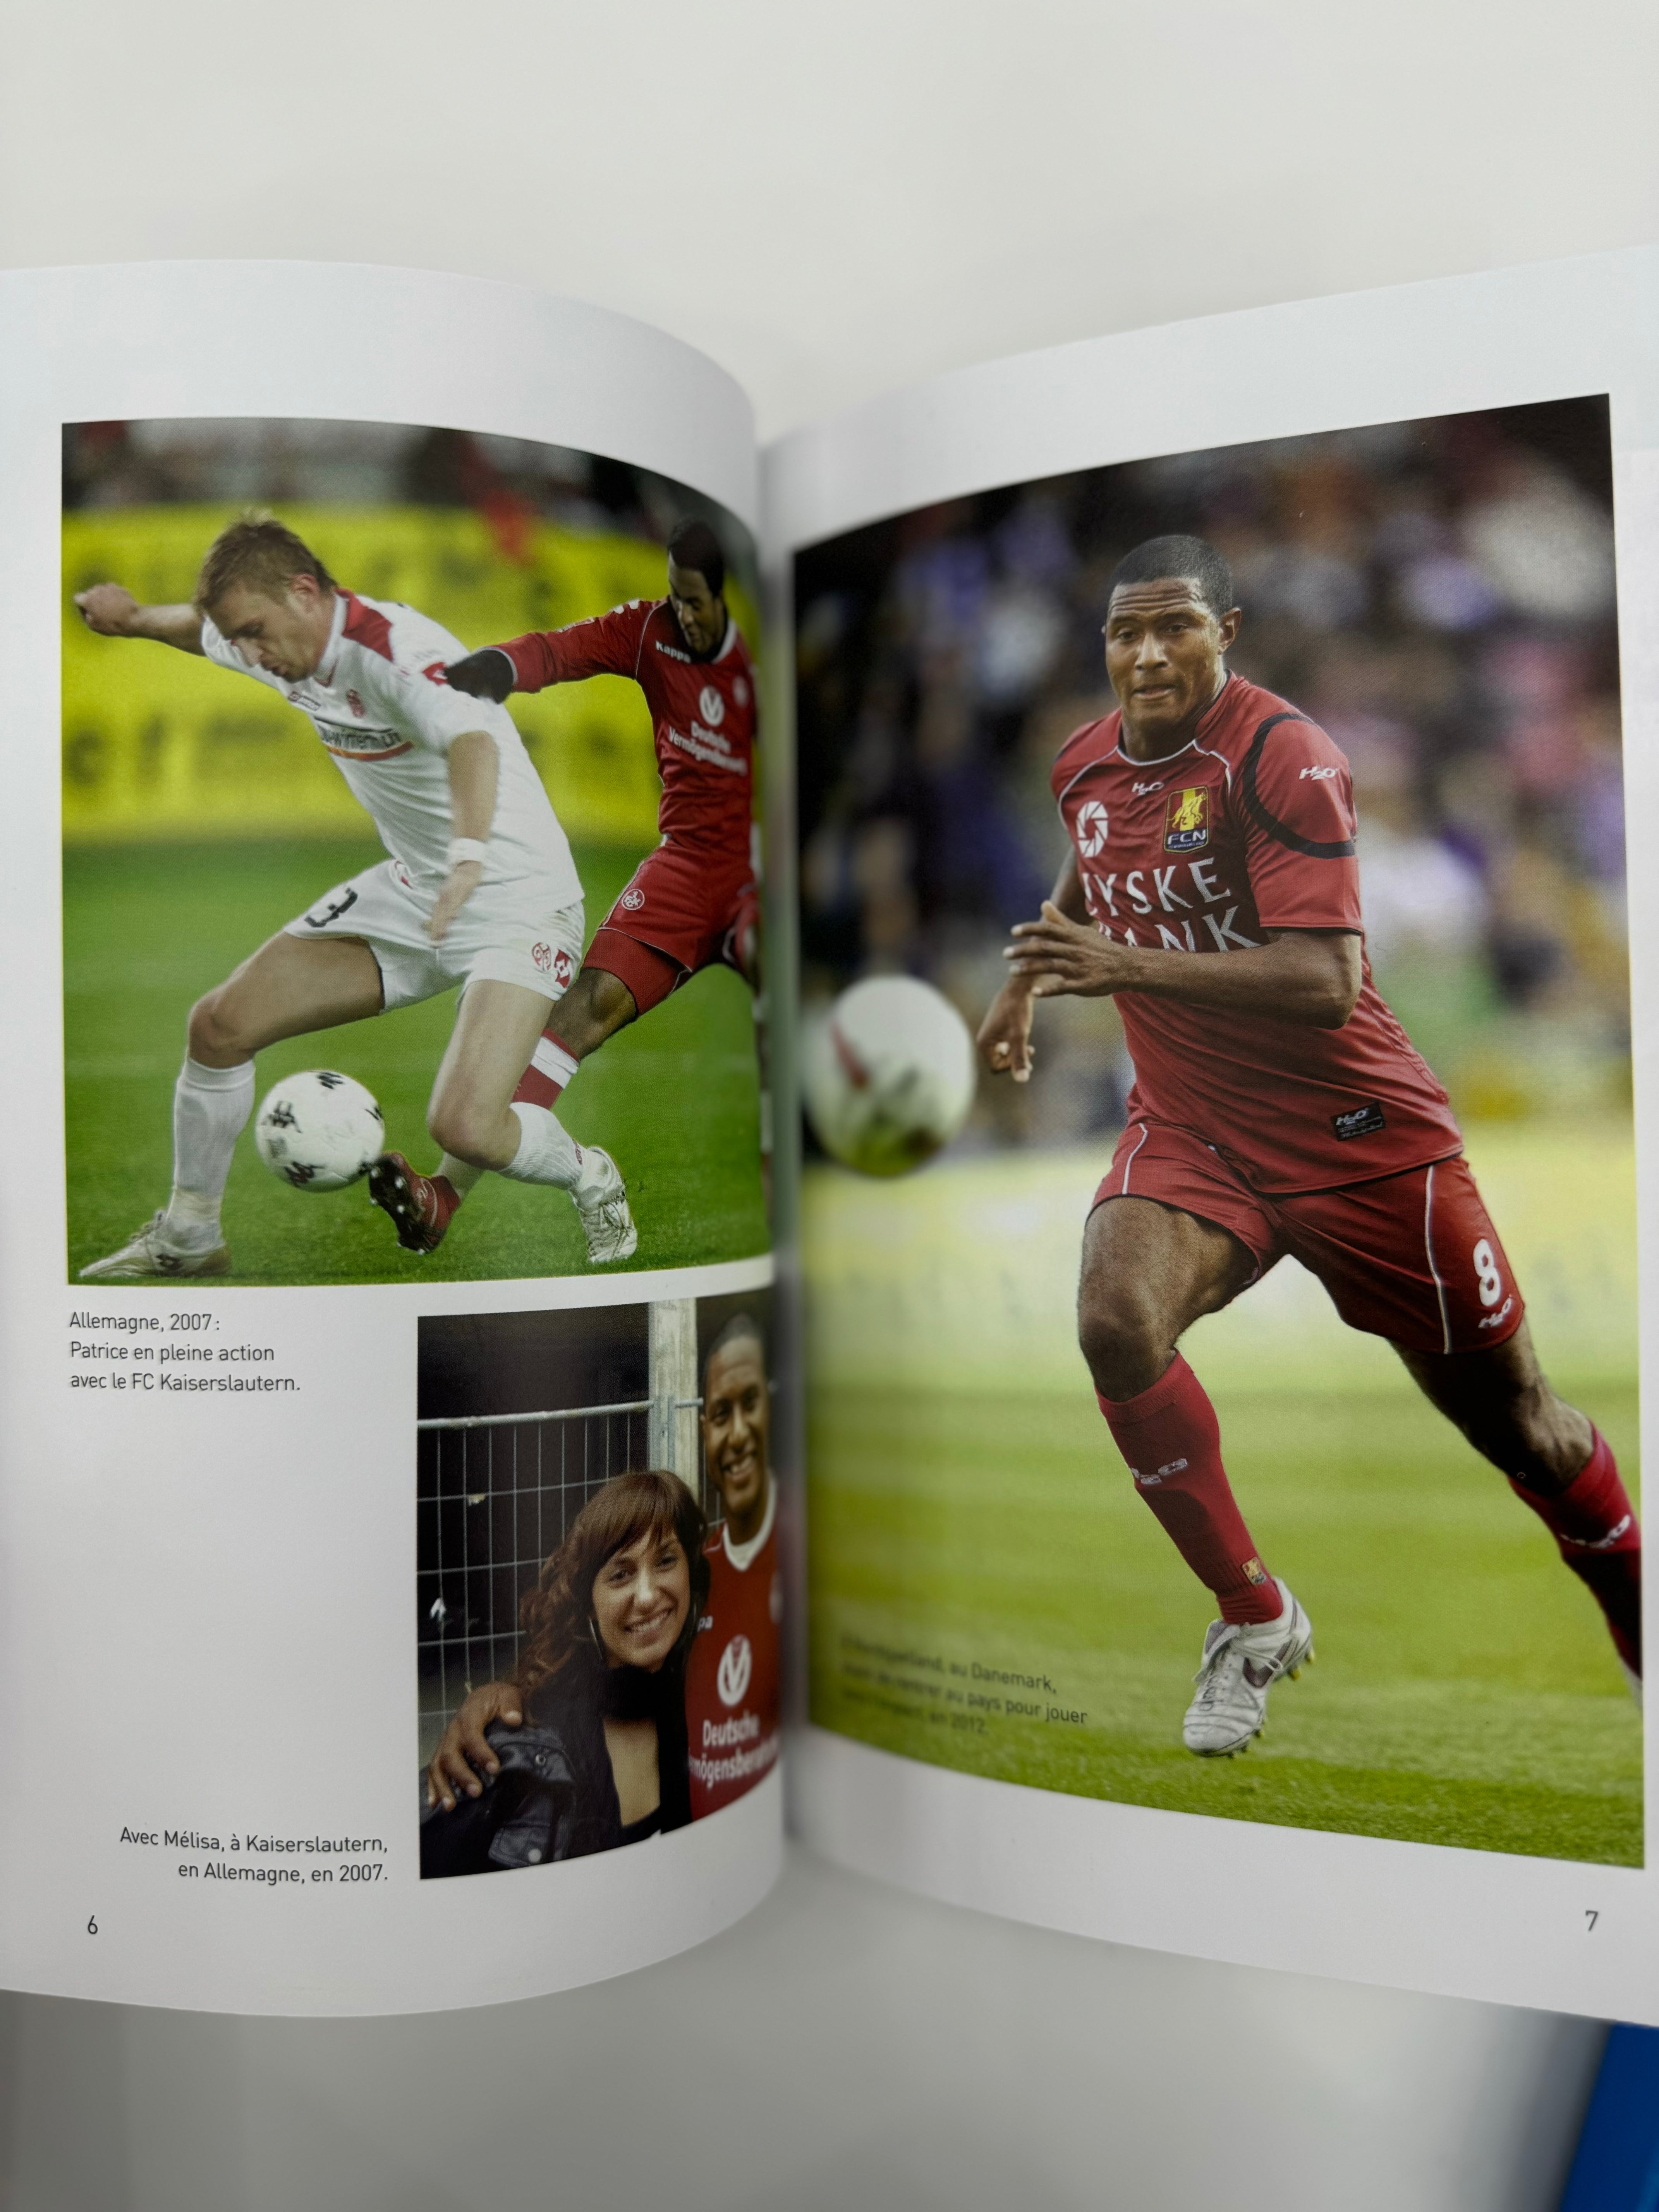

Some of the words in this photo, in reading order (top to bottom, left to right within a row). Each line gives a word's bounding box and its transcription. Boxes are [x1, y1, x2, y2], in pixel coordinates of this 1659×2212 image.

[1167, 830, 1206, 845] FCN
[1473, 1239, 1501, 1307] 8
[69, 1311, 164, 1334] Allemagne,
[70, 1341, 129, 1360] Patrice
[132, 1347, 154, 1360] en
[159, 1343, 213, 1365] pleine
[218, 1344, 274, 1361] action
[70, 1375, 107, 1389] avec
[112, 1372, 127, 1390] le
[131, 1372, 154, 1391] FC
[160, 1373, 301, 1392] Kaiserslautern.
[971, 1662, 1058, 1695] Danemark,
[967, 1692, 1001, 1712] pays
[1006, 1700, 1041, 1717] pour
[1045, 1702, 1088, 1725] jouer
[120, 1826, 159, 1846] Avec
[164, 1830, 225, 1853] Mélisa,
[230, 1833, 240, 1851] à
[246, 1834, 388, 1854] Kaiserslautern,
[178, 1865, 199, 1877] en
[203, 1862, 305, 1886] Allemagne,
[311, 1870, 333, 1882] en
[339, 1863, 388, 1882] 2007.
[87, 1915, 98, 1935] 6
[1585, 1910, 1599, 1931] 7
